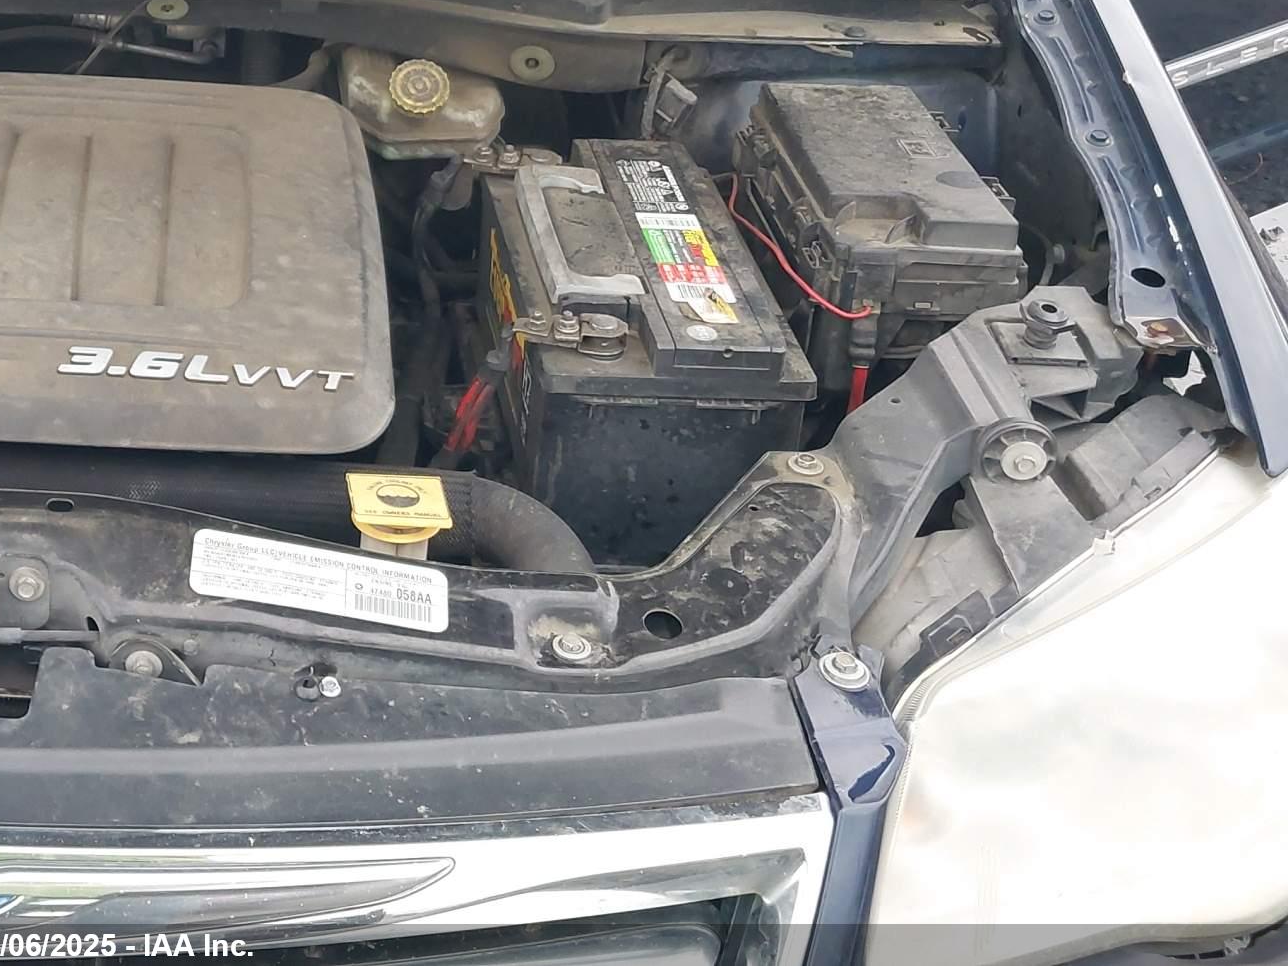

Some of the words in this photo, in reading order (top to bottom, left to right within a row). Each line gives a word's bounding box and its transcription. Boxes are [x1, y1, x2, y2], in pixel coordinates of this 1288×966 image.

[57, 345, 230, 384] 3.6L
[233, 363, 356, 392] VVT
[310, 555, 345, 568] EMISSION
[346, 562, 379, 574] CONTROL
[382, 569, 433, 585] INFORMATION
